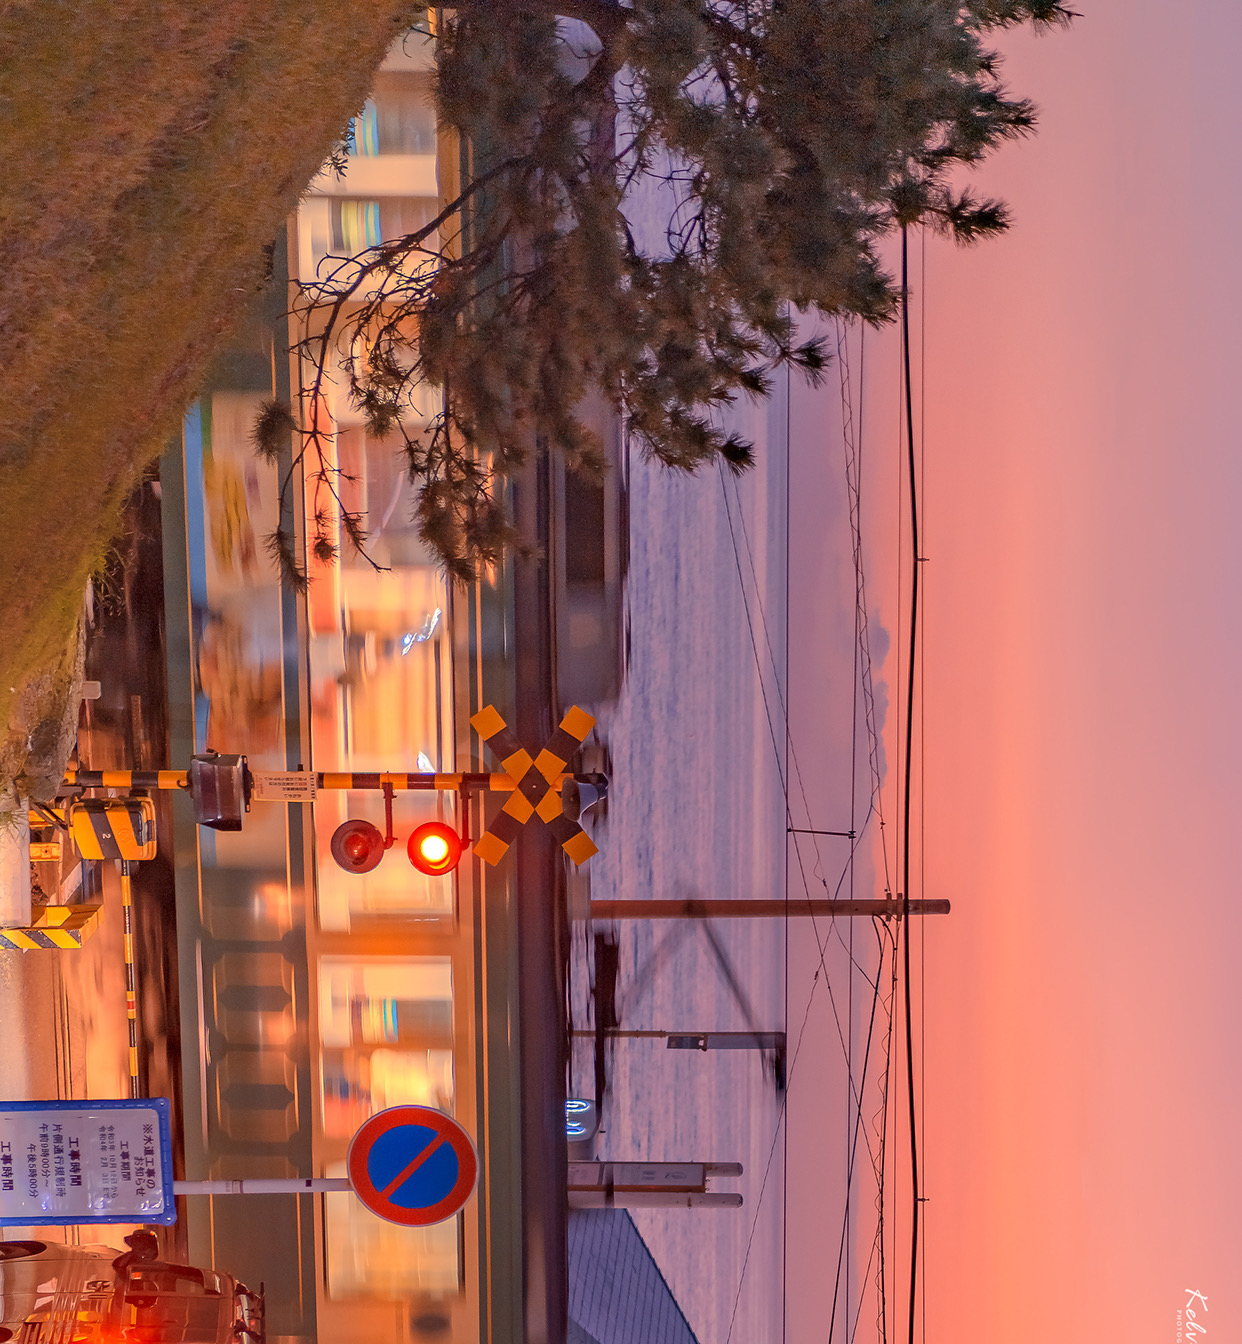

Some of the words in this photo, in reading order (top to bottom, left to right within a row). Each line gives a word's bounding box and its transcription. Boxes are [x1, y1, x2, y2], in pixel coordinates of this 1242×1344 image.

[0, 1140, 14, 1191] 工事時間
[26, 1143, 39, 1199] 午後5時00分
[52, 1123, 67, 1198] 片側通行規制時
[68, 1136, 82, 1187] 工事時間
[120, 1140, 132, 1182] 工事期間
[134, 1156, 146, 1197] お知らせ
